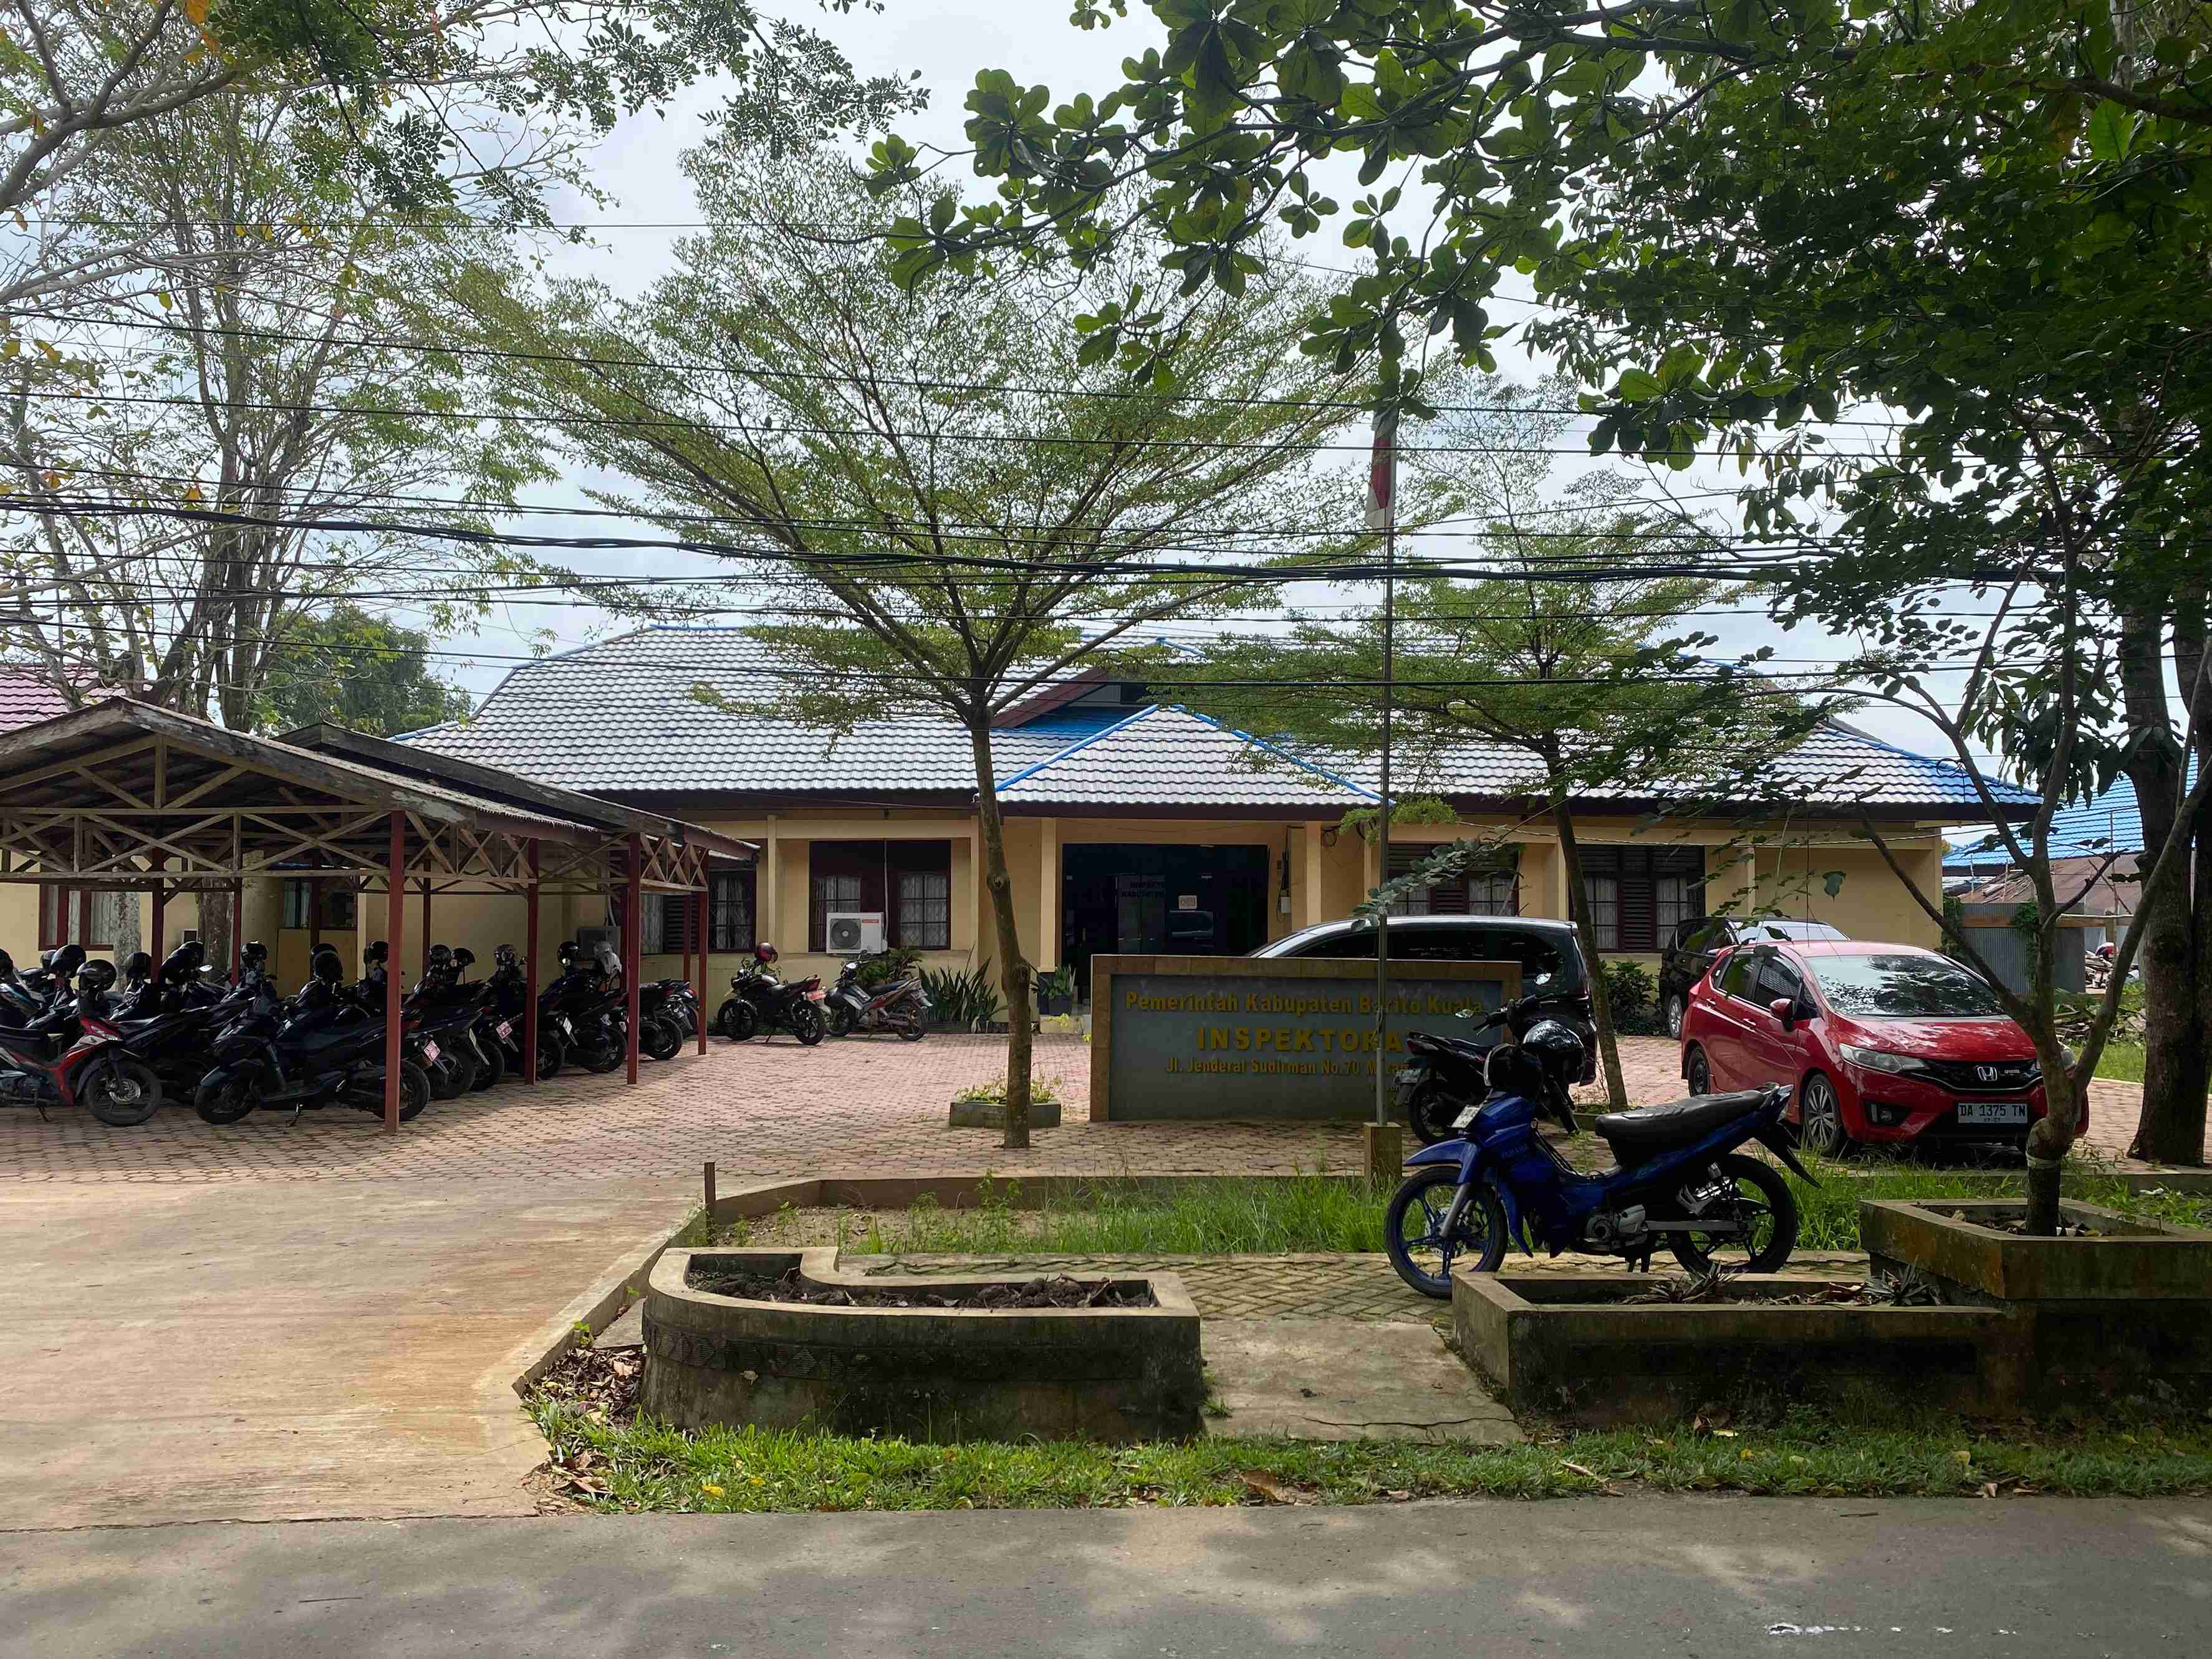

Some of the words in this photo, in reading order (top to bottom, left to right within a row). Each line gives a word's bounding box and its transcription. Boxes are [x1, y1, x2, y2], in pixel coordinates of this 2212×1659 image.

[1126, 991, 1238, 1012] Pemerintah
[1246, 993, 1352, 1017] Kabupaten
[1196, 1027, 1405, 1052] INSPEKTORA
[1187, 1057, 1246, 1073] Jenderal
[1251, 1058, 1317, 1075] Sudirman
[1960, 1105, 1973, 1117] DA
[1979, 1105, 2006, 1117] 1375
